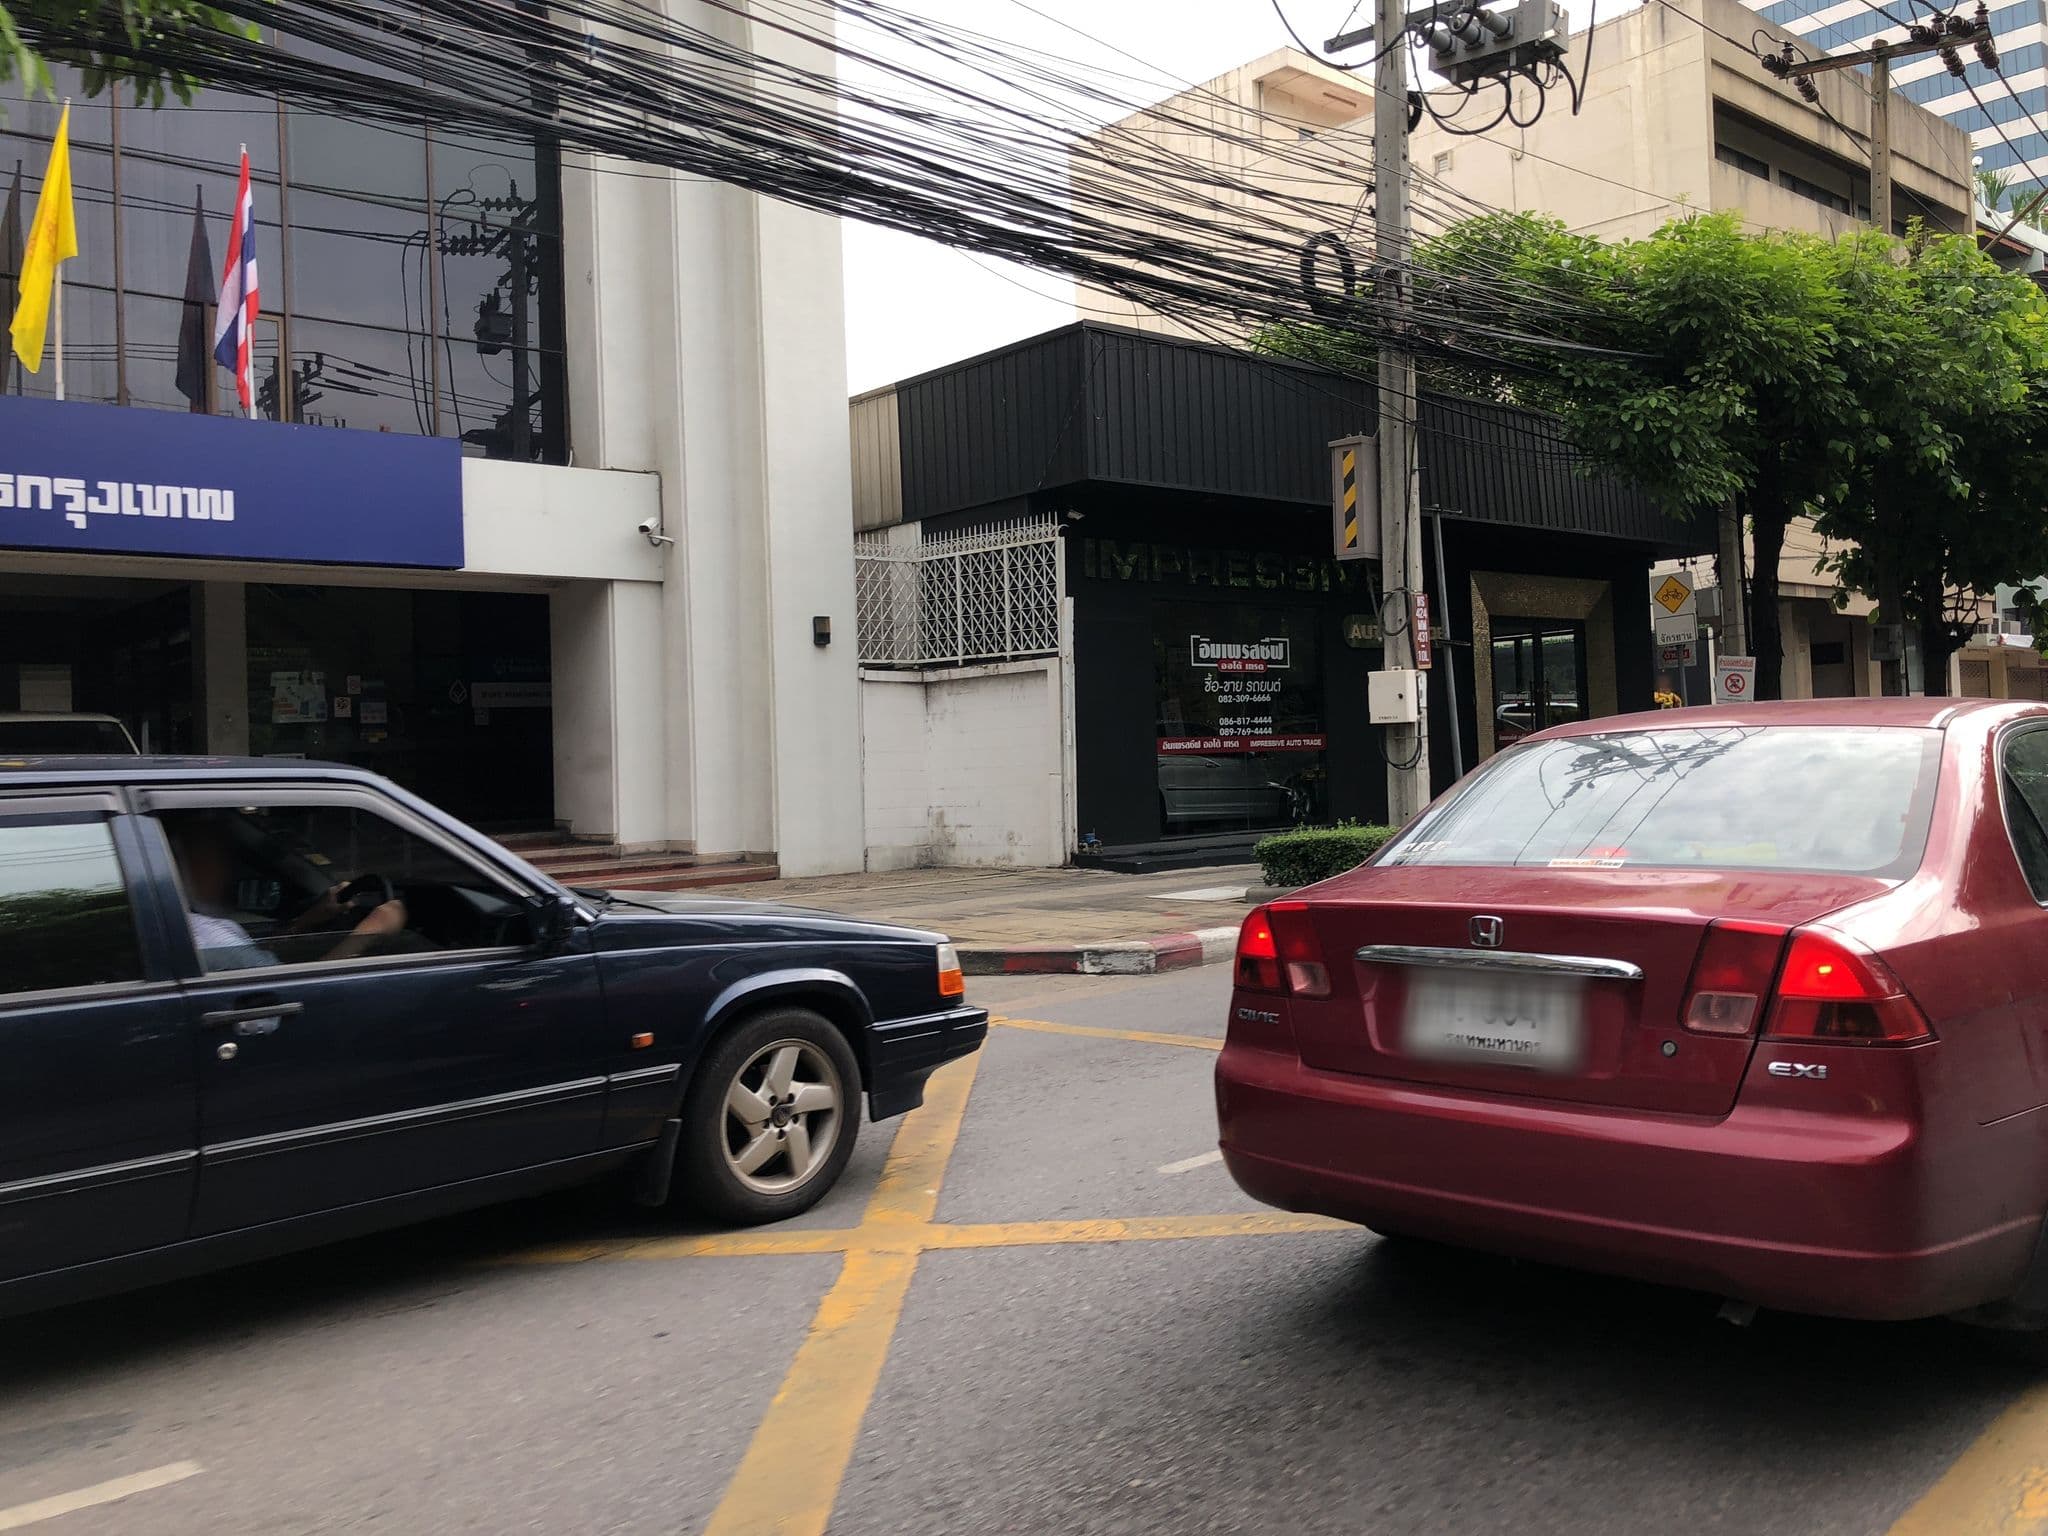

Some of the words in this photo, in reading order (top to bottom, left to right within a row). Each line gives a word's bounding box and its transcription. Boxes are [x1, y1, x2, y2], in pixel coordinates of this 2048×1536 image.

[1660, 632, 1692, 643] จักรยาน
[1246, 678, 1281, 693] รถยนต์
[1218, 694, 1272, 703] 082-309-6666
[1219, 716, 1273, 726] 086-817-4444
[1219, 727, 1273, 736] 089-769-4444
